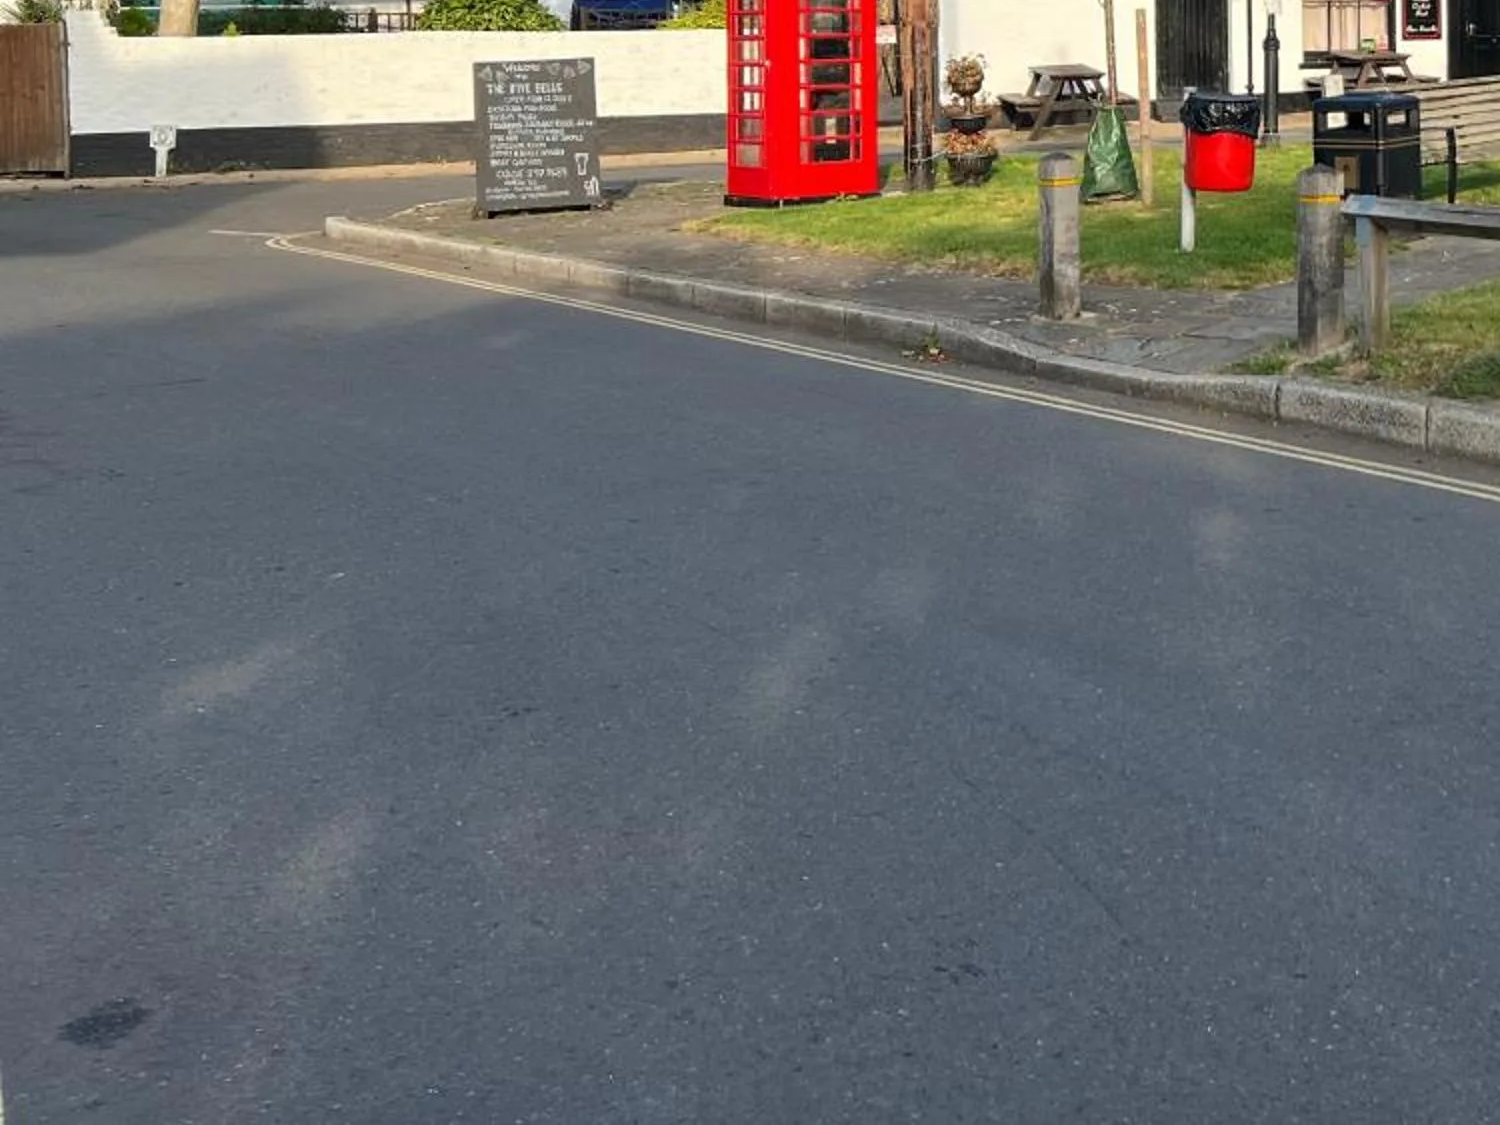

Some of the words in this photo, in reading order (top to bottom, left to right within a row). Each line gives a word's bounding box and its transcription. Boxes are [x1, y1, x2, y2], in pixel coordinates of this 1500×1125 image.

[485, 83, 505, 95] THE
[509, 83, 531, 94] FIVE
[535, 82, 564, 94] BELLS
